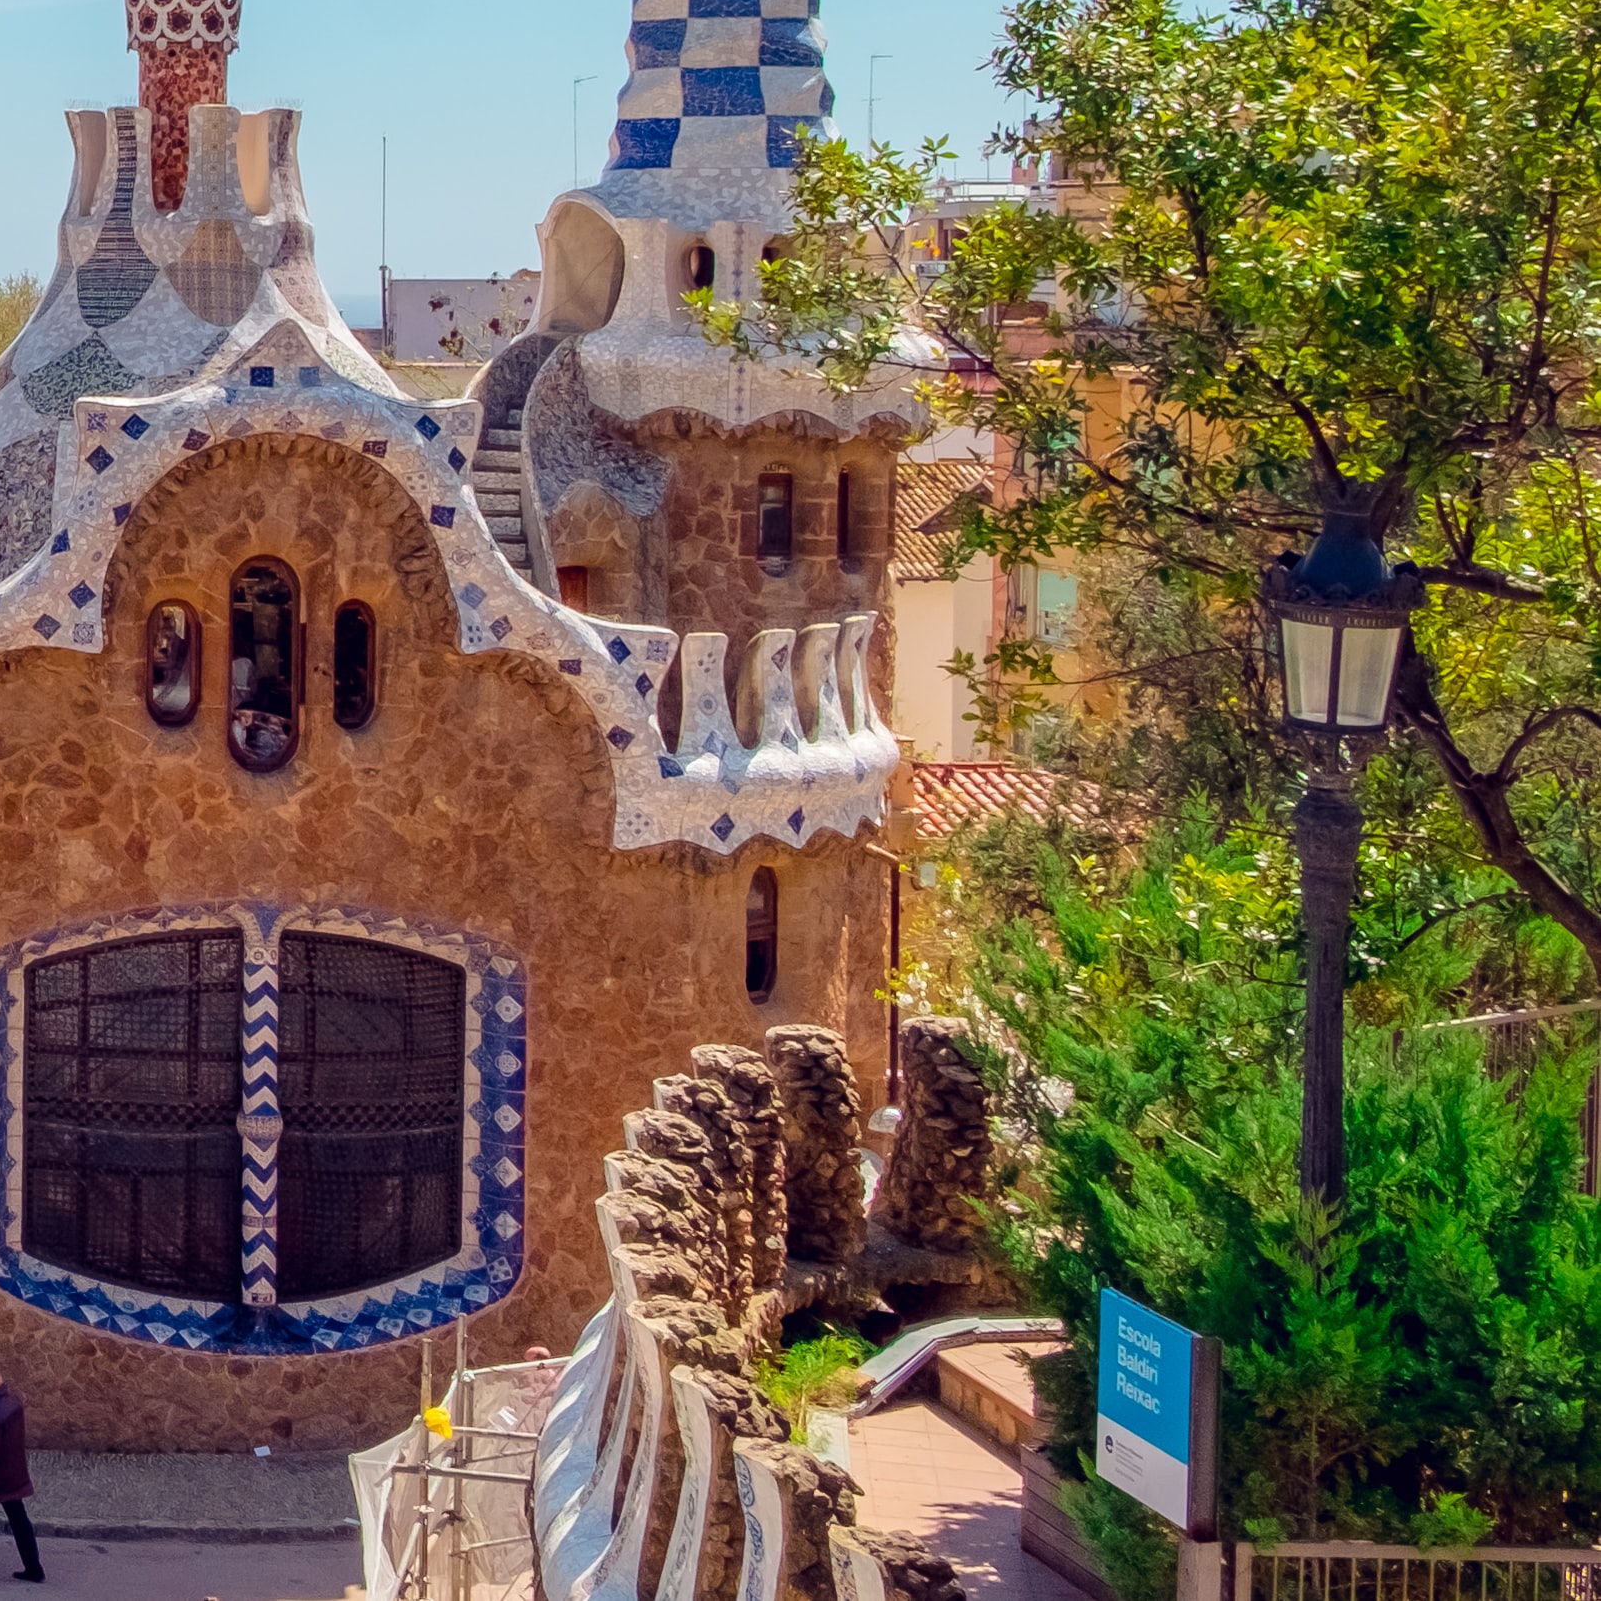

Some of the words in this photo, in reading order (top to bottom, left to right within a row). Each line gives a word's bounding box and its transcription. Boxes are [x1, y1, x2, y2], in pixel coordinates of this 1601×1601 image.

[1118, 1315, 1161, 1358] Escola
[1117, 1343, 1158, 1385] Baldiri
[1116, 1371, 1161, 1414] Reixac
